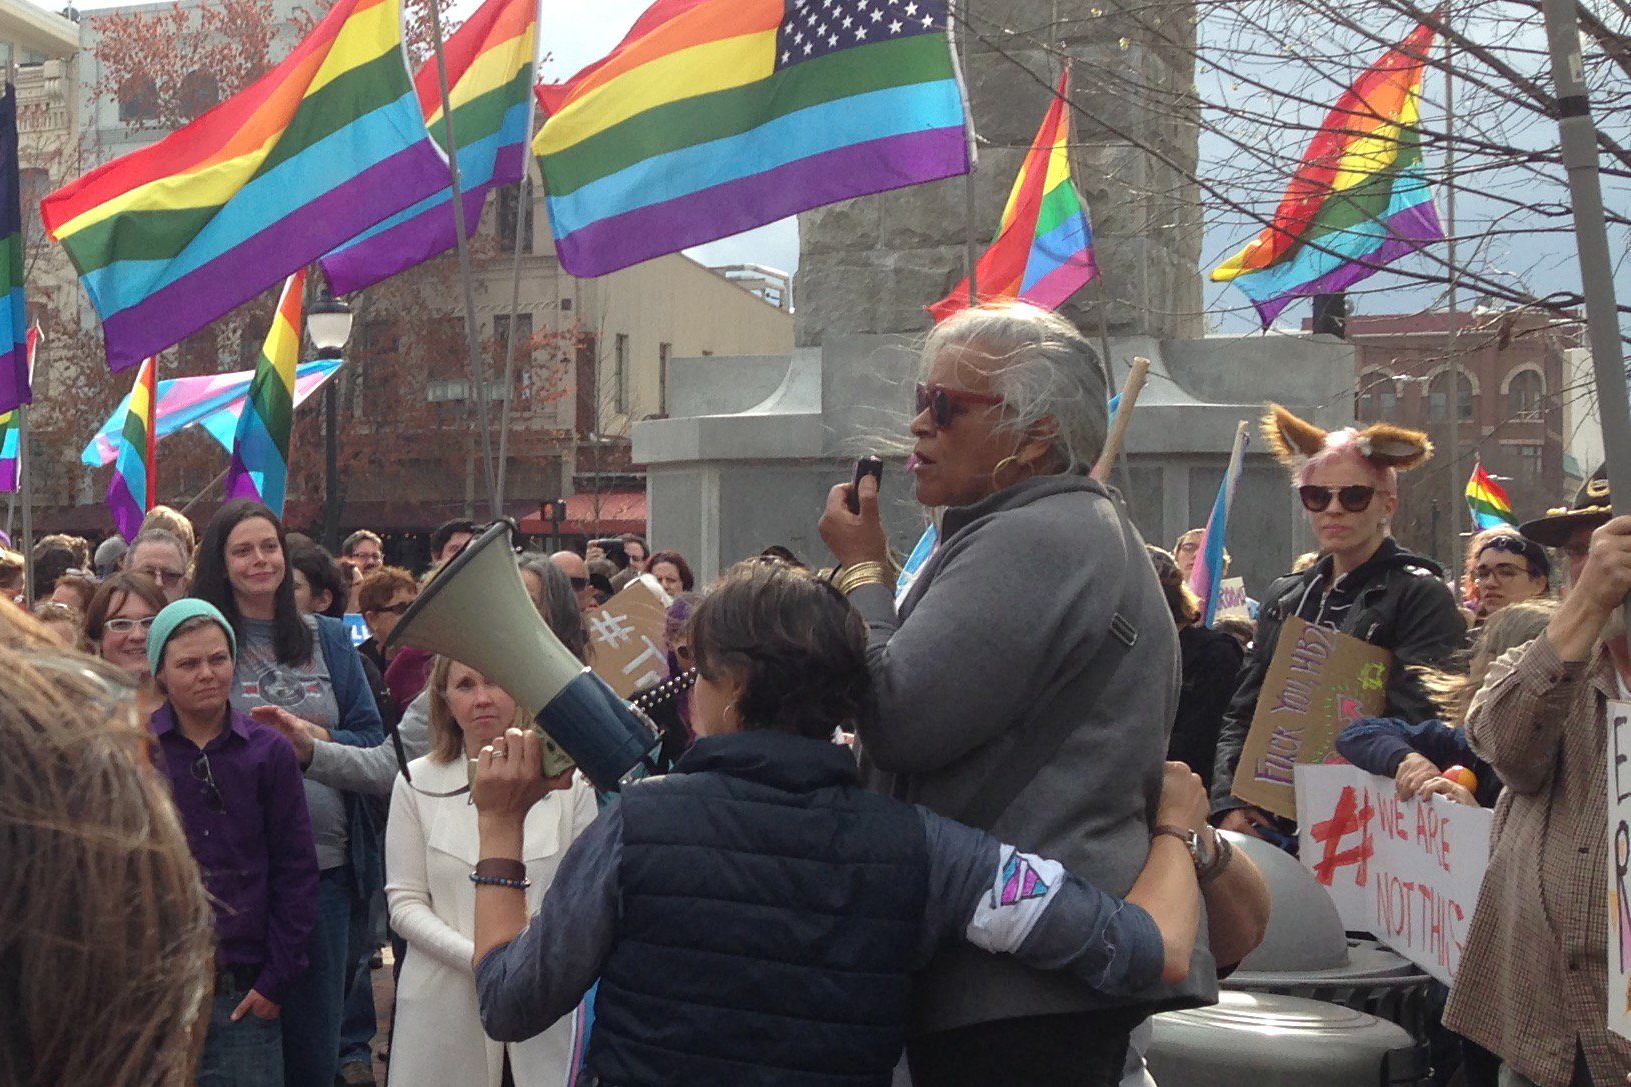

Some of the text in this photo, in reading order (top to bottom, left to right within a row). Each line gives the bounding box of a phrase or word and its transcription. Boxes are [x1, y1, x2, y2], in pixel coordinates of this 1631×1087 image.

[1377, 792, 1408, 840] WE
[1417, 799, 1451, 872] ARE
[1377, 872, 1467, 977] NOT THIS
